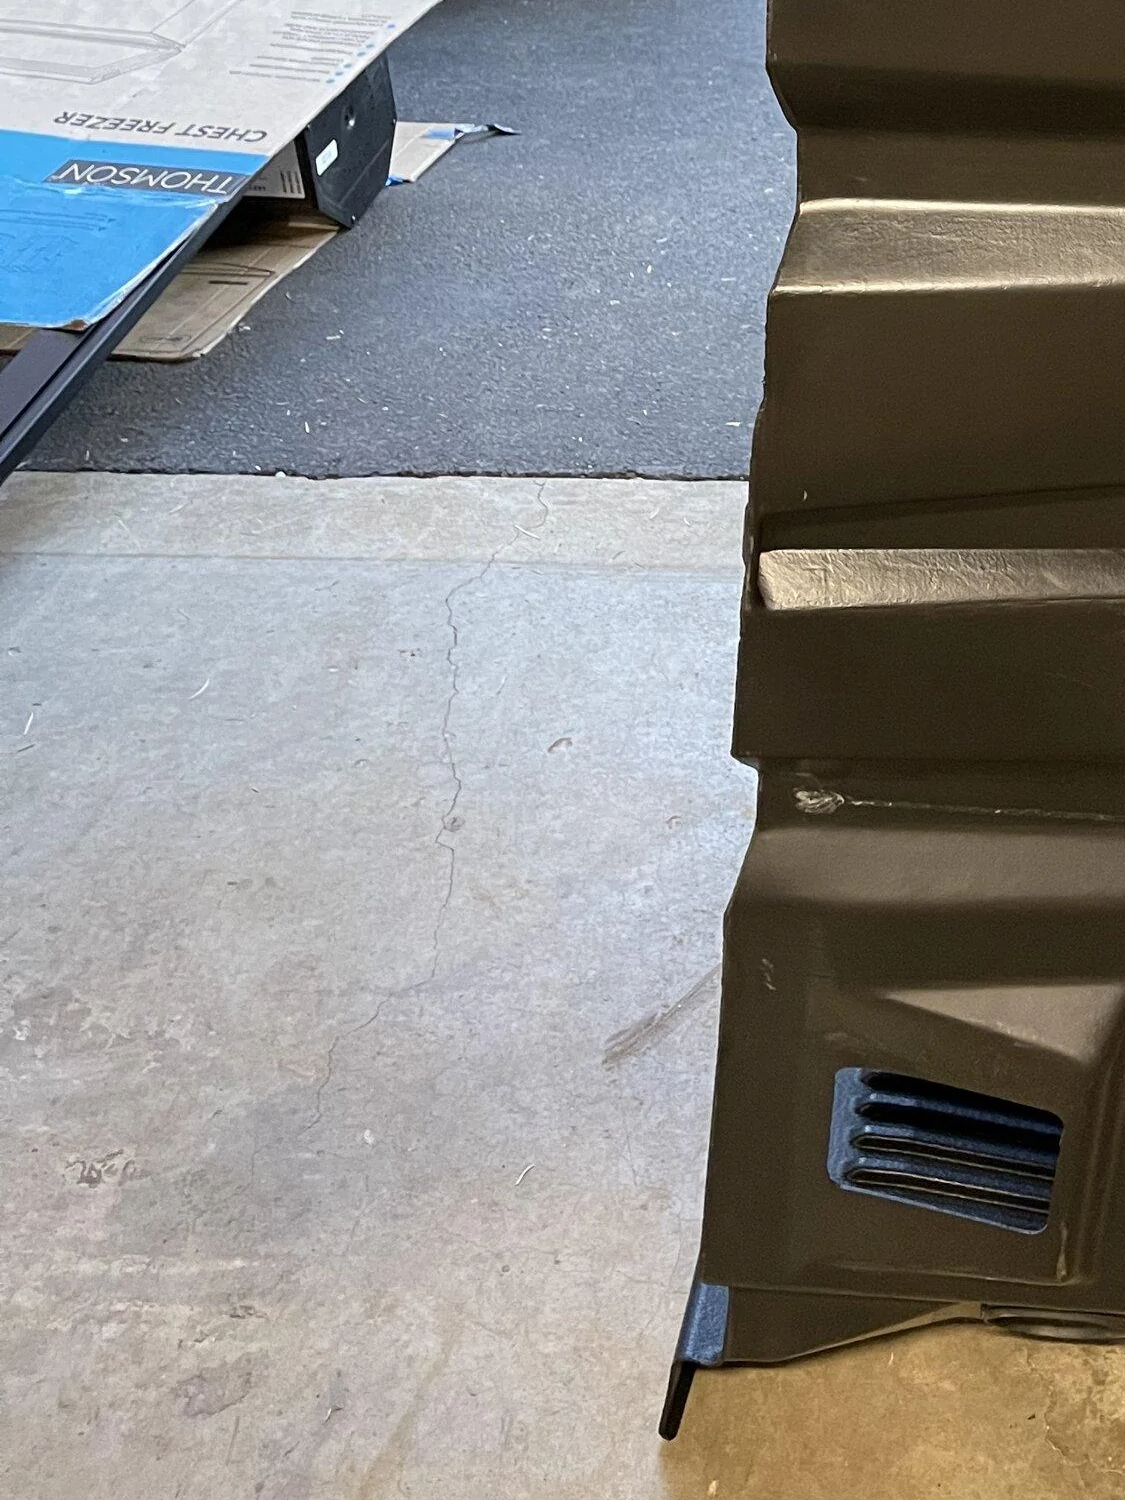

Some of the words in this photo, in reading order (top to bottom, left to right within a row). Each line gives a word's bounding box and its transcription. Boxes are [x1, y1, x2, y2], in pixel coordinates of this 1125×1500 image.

[53, 110, 176, 135] FREEZER
[175, 124, 268, 143] CHEST
[58, 163, 234, 195] THOMSON
